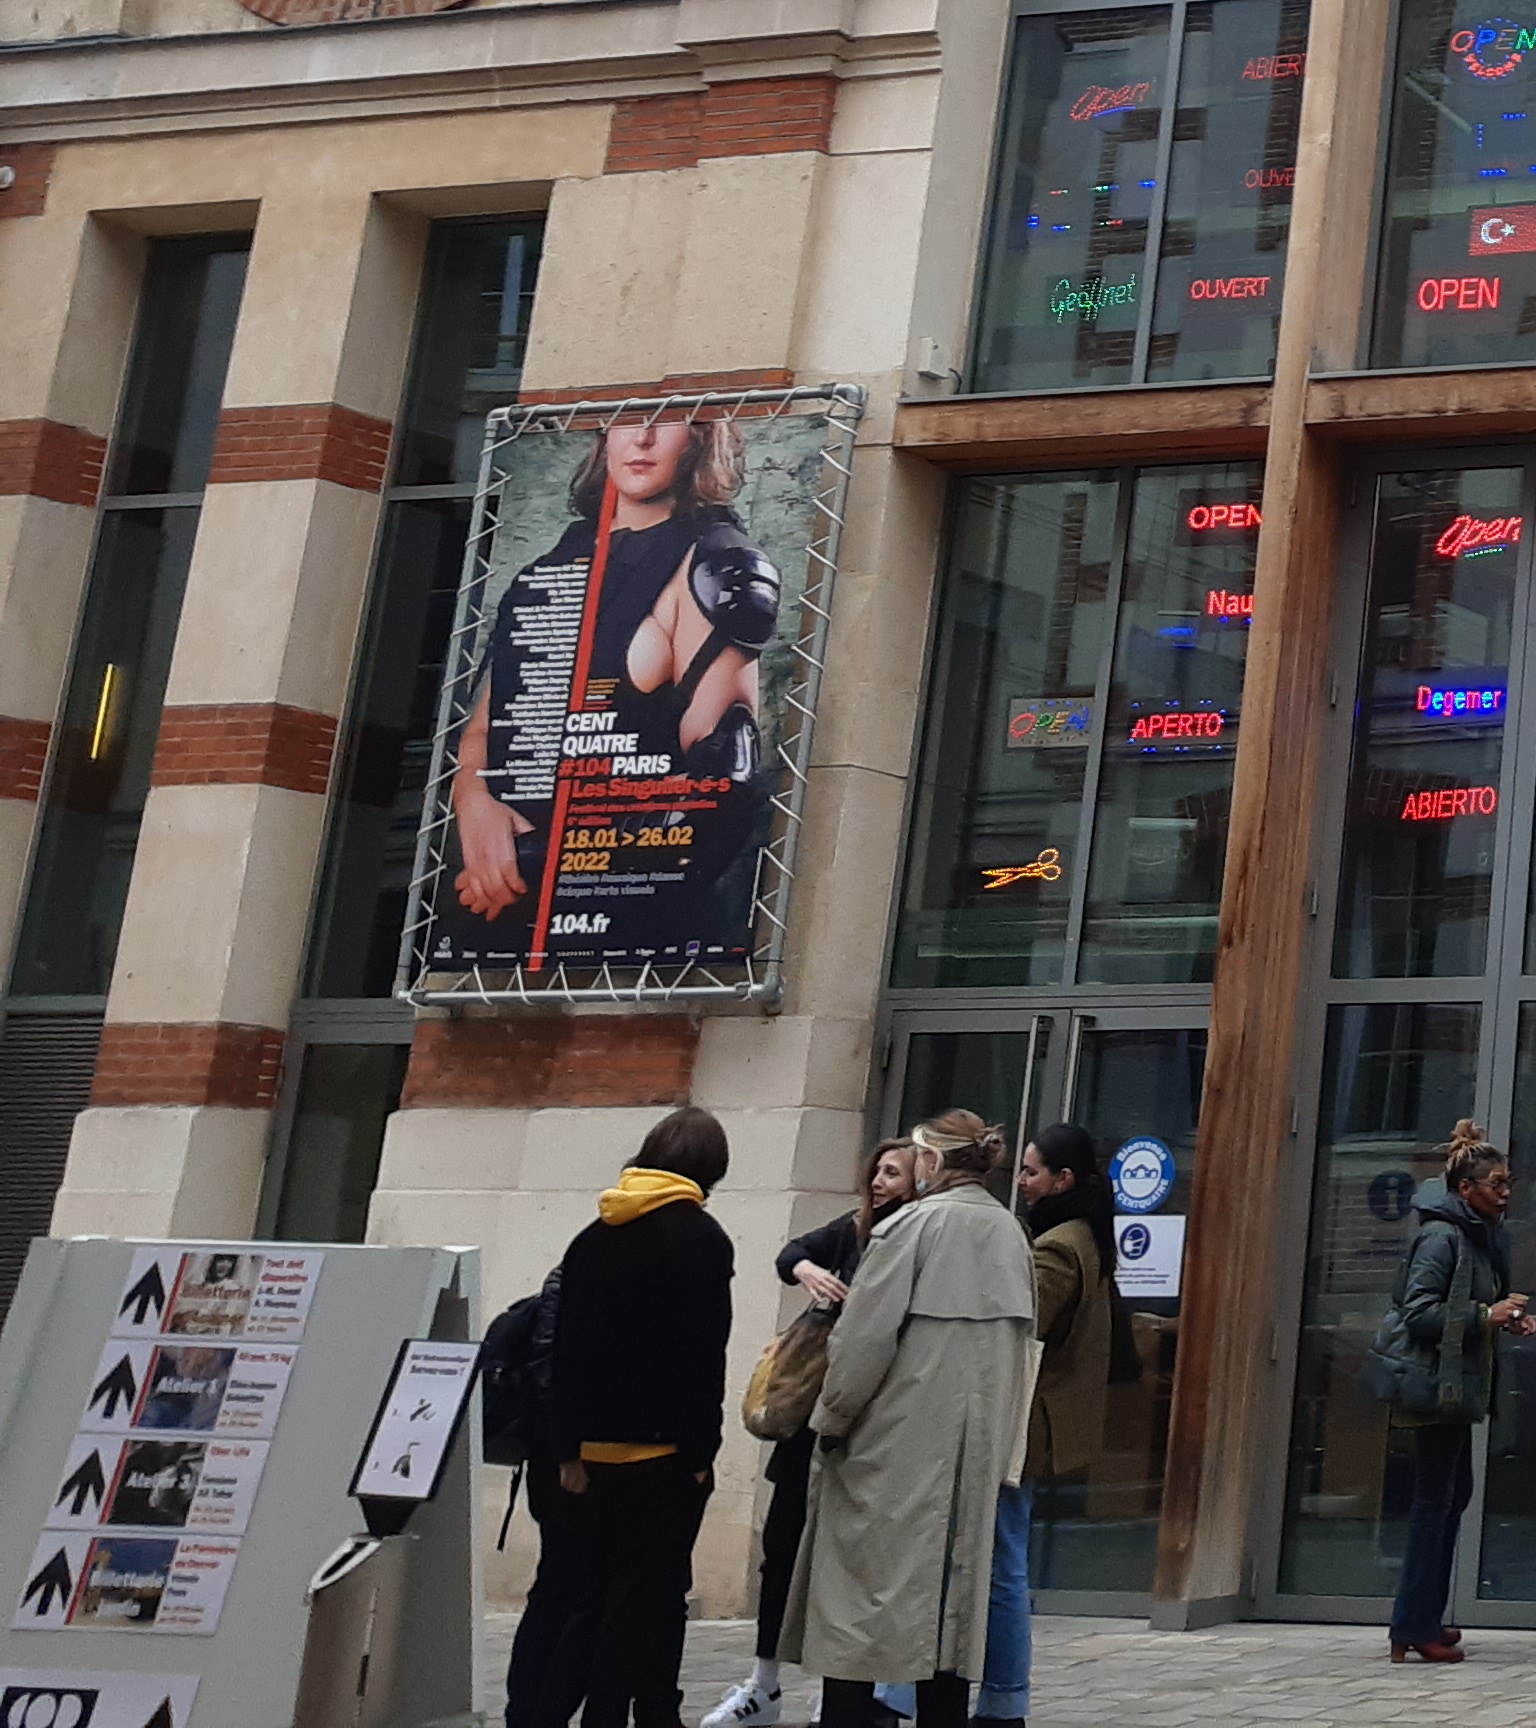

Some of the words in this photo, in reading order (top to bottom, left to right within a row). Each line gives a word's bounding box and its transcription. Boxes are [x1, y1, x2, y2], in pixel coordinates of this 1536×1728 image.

[1190, 276, 1270, 300] OUVERT
[1418, 276, 1499, 311] OPEN
[1435, 515, 1522, 556] Open
[565, 711, 618, 732] CENT
[1009, 706, 1088, 737] OPEN
[1131, 712, 1221, 738] APERTO
[562, 732, 639, 757] QUATRE
[571, 778, 607, 798] Les
[1402, 785, 1495, 820] ABIERTO
[563, 827, 618, 849] 18.01
[636, 825, 693, 847] 26.02
[560, 850, 611, 872] 2022
[550, 912, 611, 935] 104.fr
